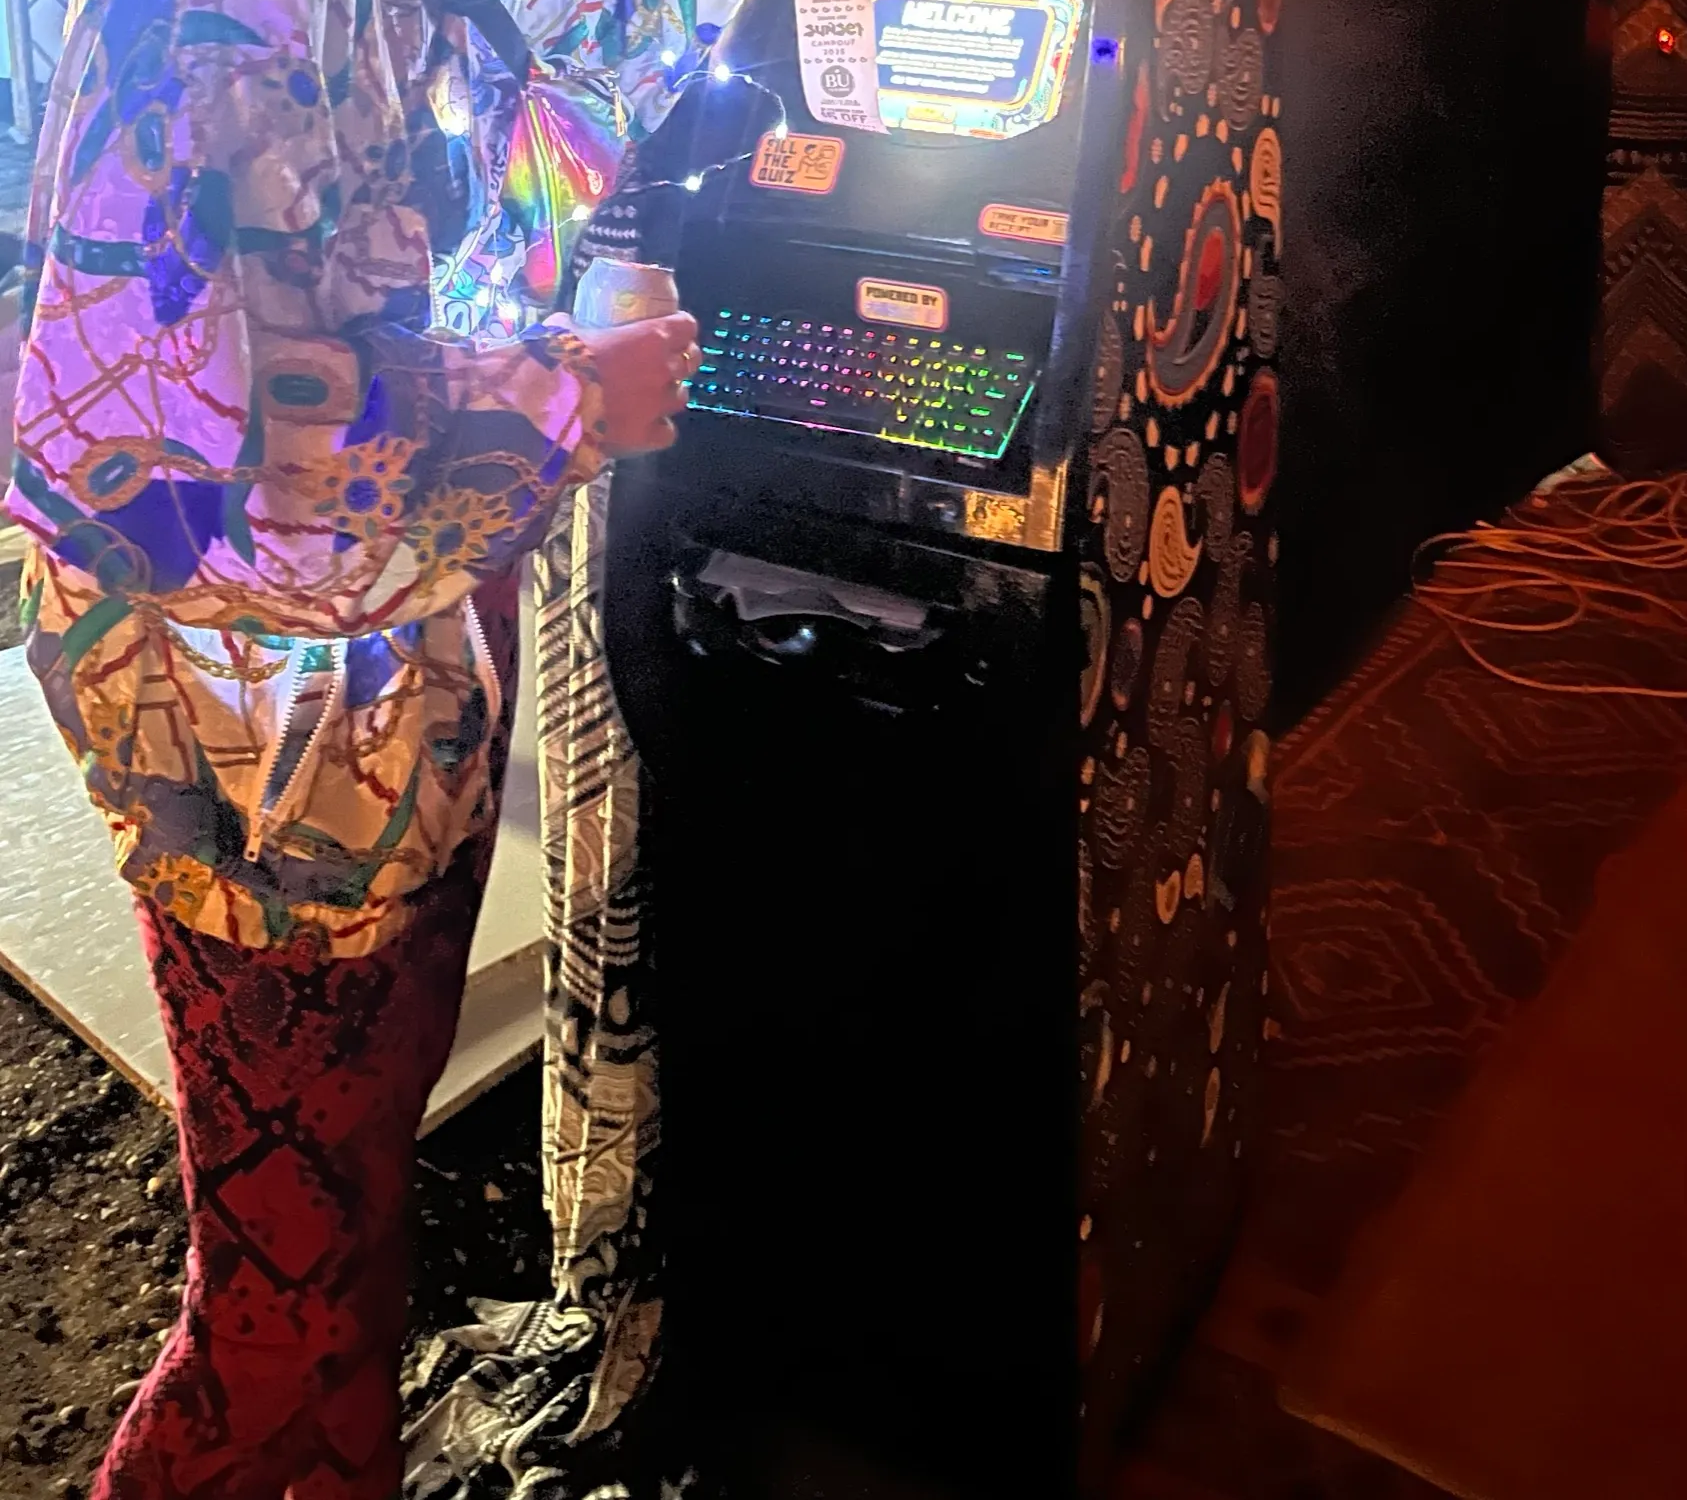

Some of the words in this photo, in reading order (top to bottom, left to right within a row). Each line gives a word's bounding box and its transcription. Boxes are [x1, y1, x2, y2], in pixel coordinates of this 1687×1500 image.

[901, 0, 1016, 36] WELCOME
[811, 38, 856, 47] CAMPOUT
[763, 153, 793, 169] THE
[757, 167, 797, 184] QUIZ
[865, 286, 918, 304] POWERED
[921, 294, 939, 306] BY
